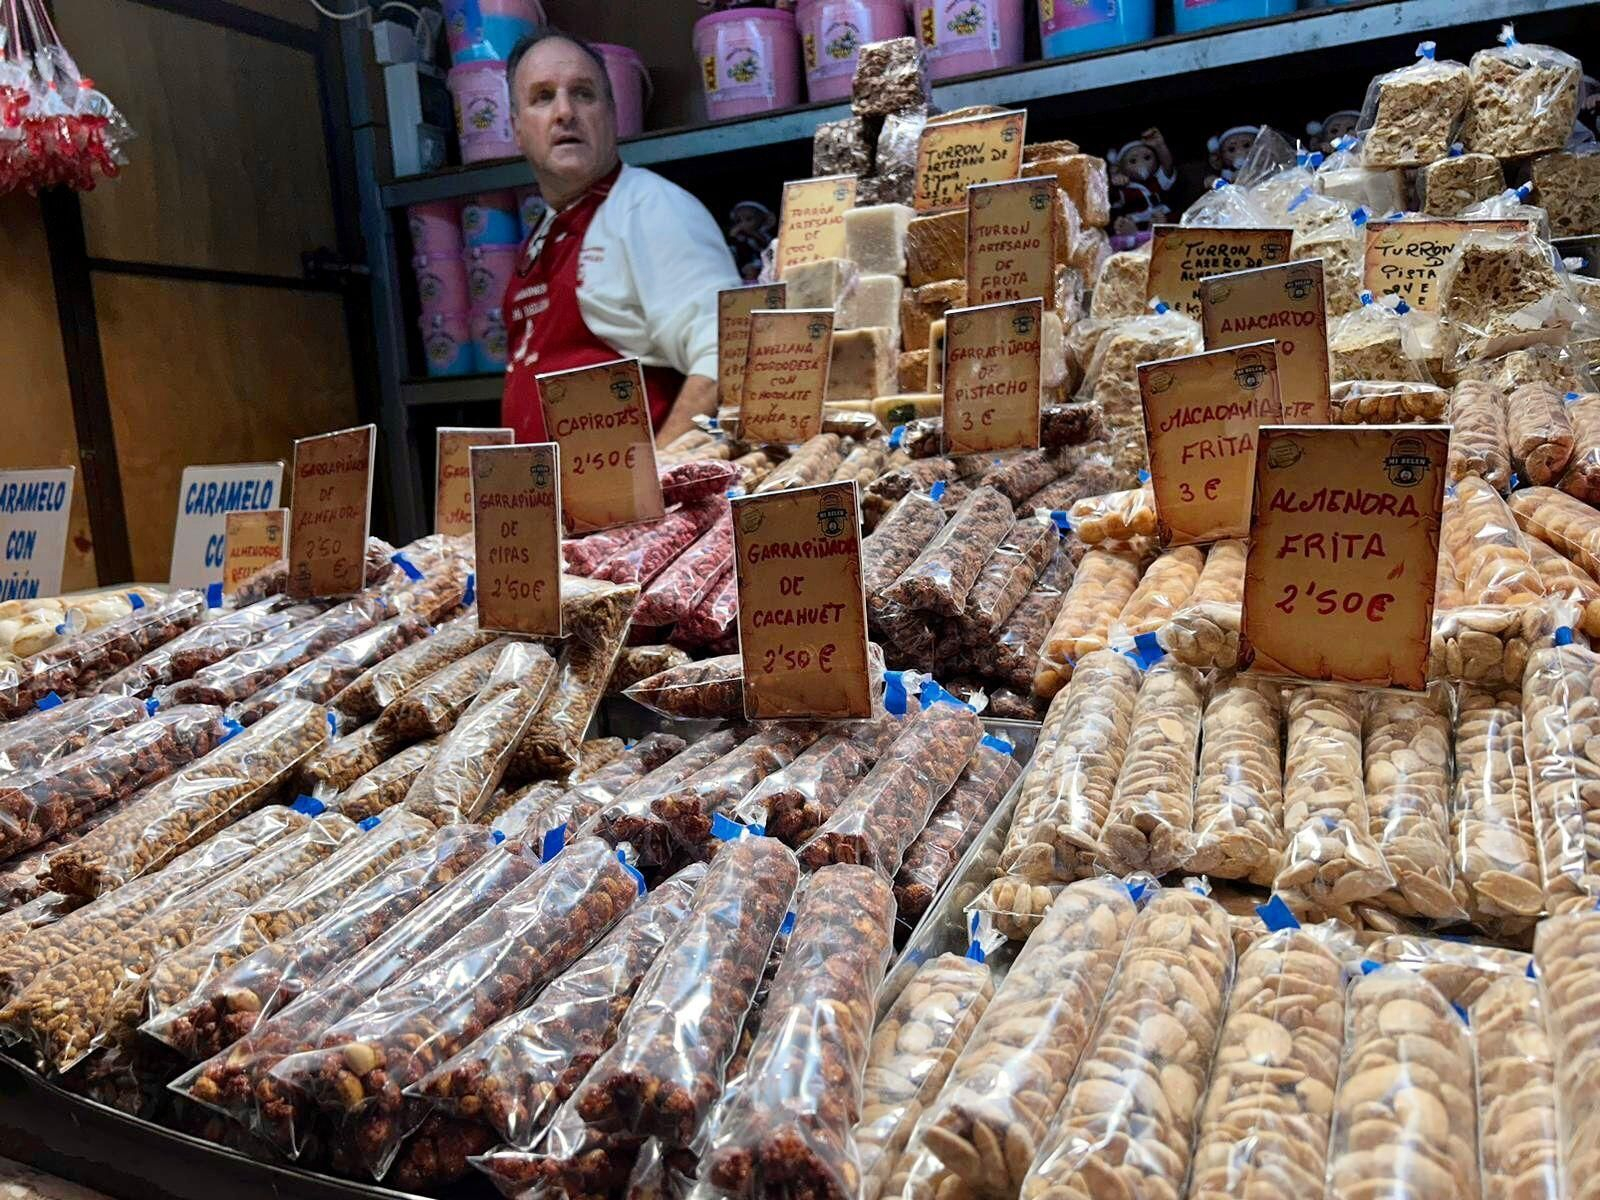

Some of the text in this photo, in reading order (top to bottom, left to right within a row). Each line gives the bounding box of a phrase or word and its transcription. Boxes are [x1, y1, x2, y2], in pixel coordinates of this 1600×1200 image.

[975, 220, 1030, 237] TURRON
[979, 239, 1041, 254] ARTESANO
[1185, 241, 1251, 258] TURRON
[995, 260, 1014, 271] DE
[980, 271, 1028, 290] FRUTA
[1220, 310, 1316, 334] ANACARDO
[950, 338, 1040, 362] GARRAPIÑADA
[770, 375, 797, 387] CON
[955, 380, 1028, 401] PISTACHO
[556, 405, 641, 437] CAPIROTES
[1160, 398, 1272, 432] MACADAMIA
[1182, 432, 1255, 464] FRITA
[0, 482, 66, 513] ARAMELO
[185, 480, 273, 516] CARAMELO
[319, 487, 334, 502] DE
[1269, 487, 1420, 518] ALMENDRA
[501, 521, 518, 538] DE
[6, 530, 37, 560] CON
[205, 534, 225, 568] CO
[489, 547, 530, 564] PIPAS
[748, 537, 858, 564] GARRAPIÑADA
[1275, 531, 1387, 563] FRITA
[0, 567, 40, 599] IÑÓN
[780, 576, 805, 596] DE
[753, 602, 847, 628] CACAHUET
